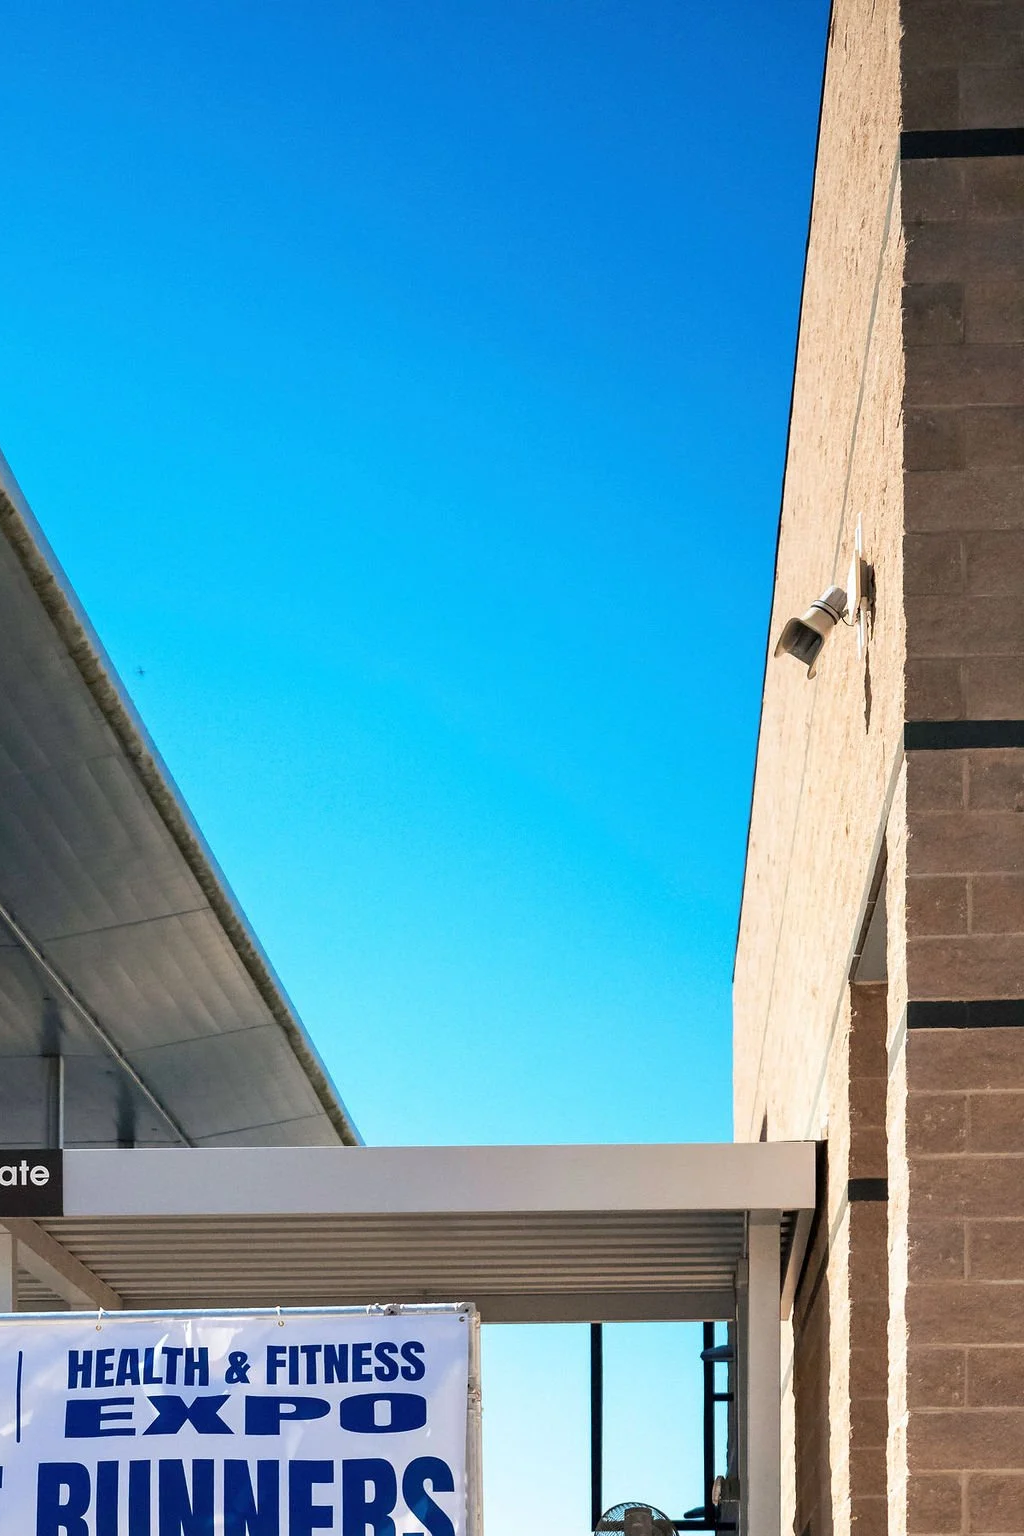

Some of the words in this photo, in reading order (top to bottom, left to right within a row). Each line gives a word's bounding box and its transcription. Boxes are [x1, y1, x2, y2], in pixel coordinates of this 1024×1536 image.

[68, 1346, 209, 1389] HEALTH
[225, 1351, 250, 1384] &
[266, 1341, 425, 1385] FITNESS
[65, 1393, 427, 1438] EXPO
